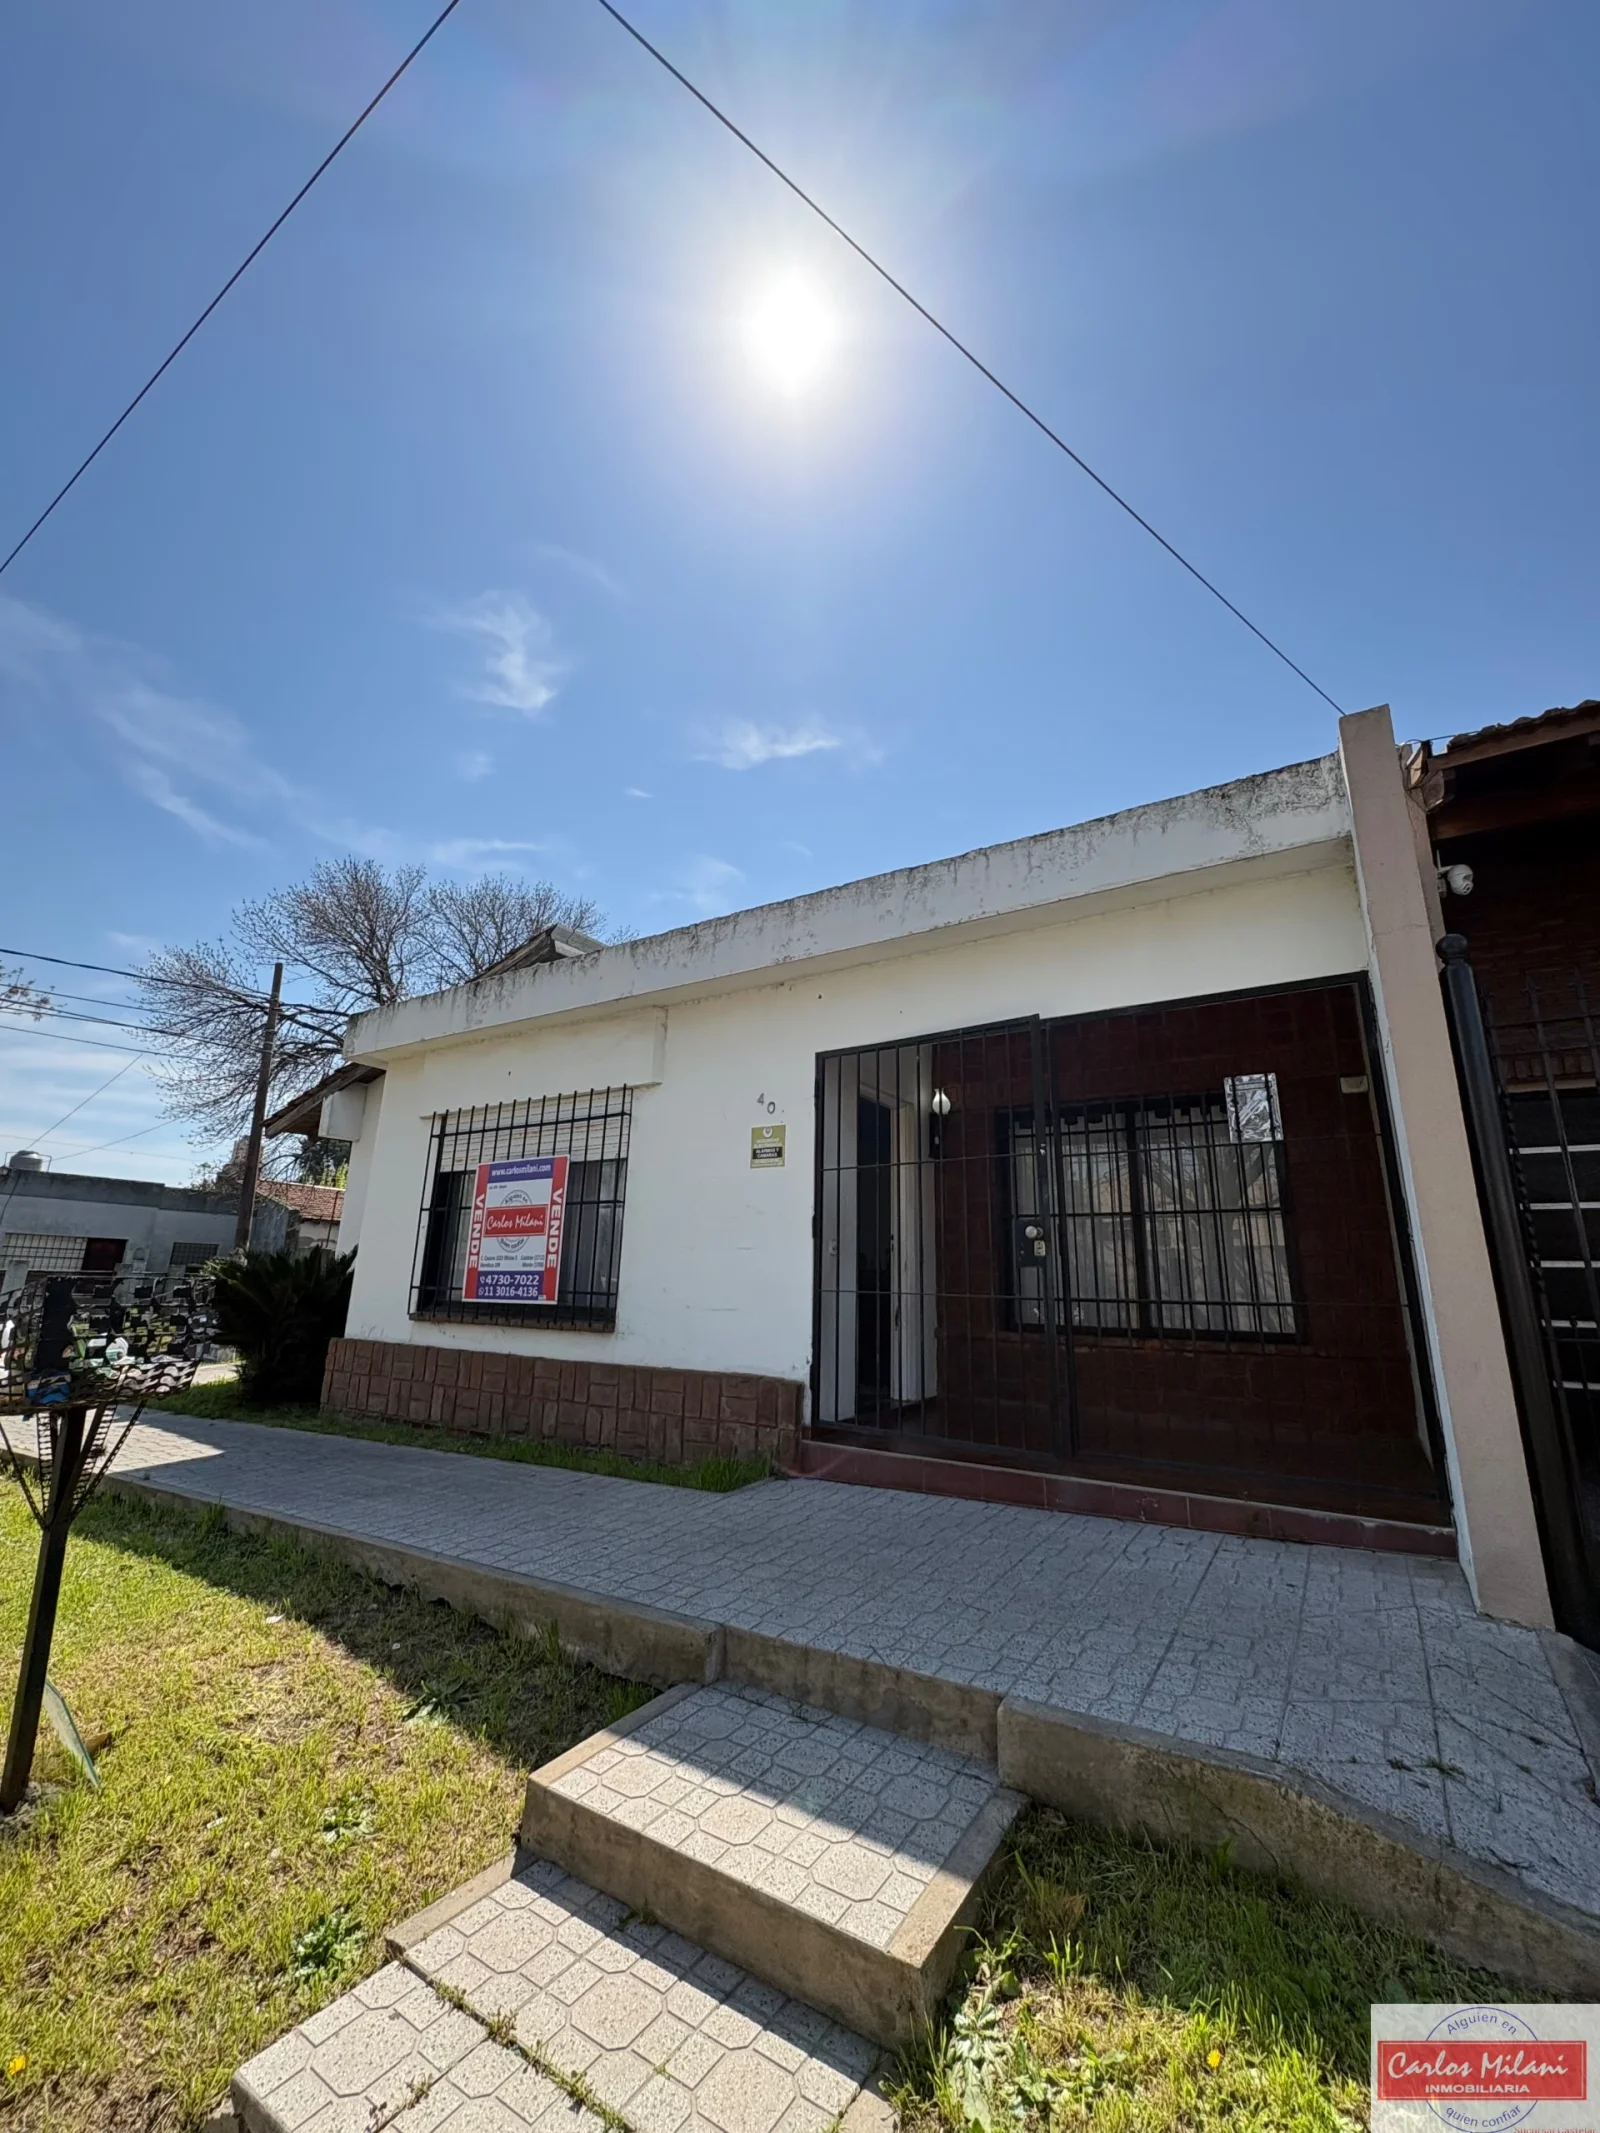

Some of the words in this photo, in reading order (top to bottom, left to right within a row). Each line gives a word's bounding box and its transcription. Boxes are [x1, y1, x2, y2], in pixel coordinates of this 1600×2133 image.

[491, 1164, 551, 1176] www.carlosmilani.com
[487, 1214, 513, 1230] Carlos
[515, 1213, 544, 1229] Milani
[547, 1188, 563, 1268] VENDE
[469, 1193, 485, 1268] VENDE
[485, 1274, 540, 1285] 4730-7022
[484, 1286, 494, 1296] 11
[495, 1286, 539, 1297] 3016-4136
